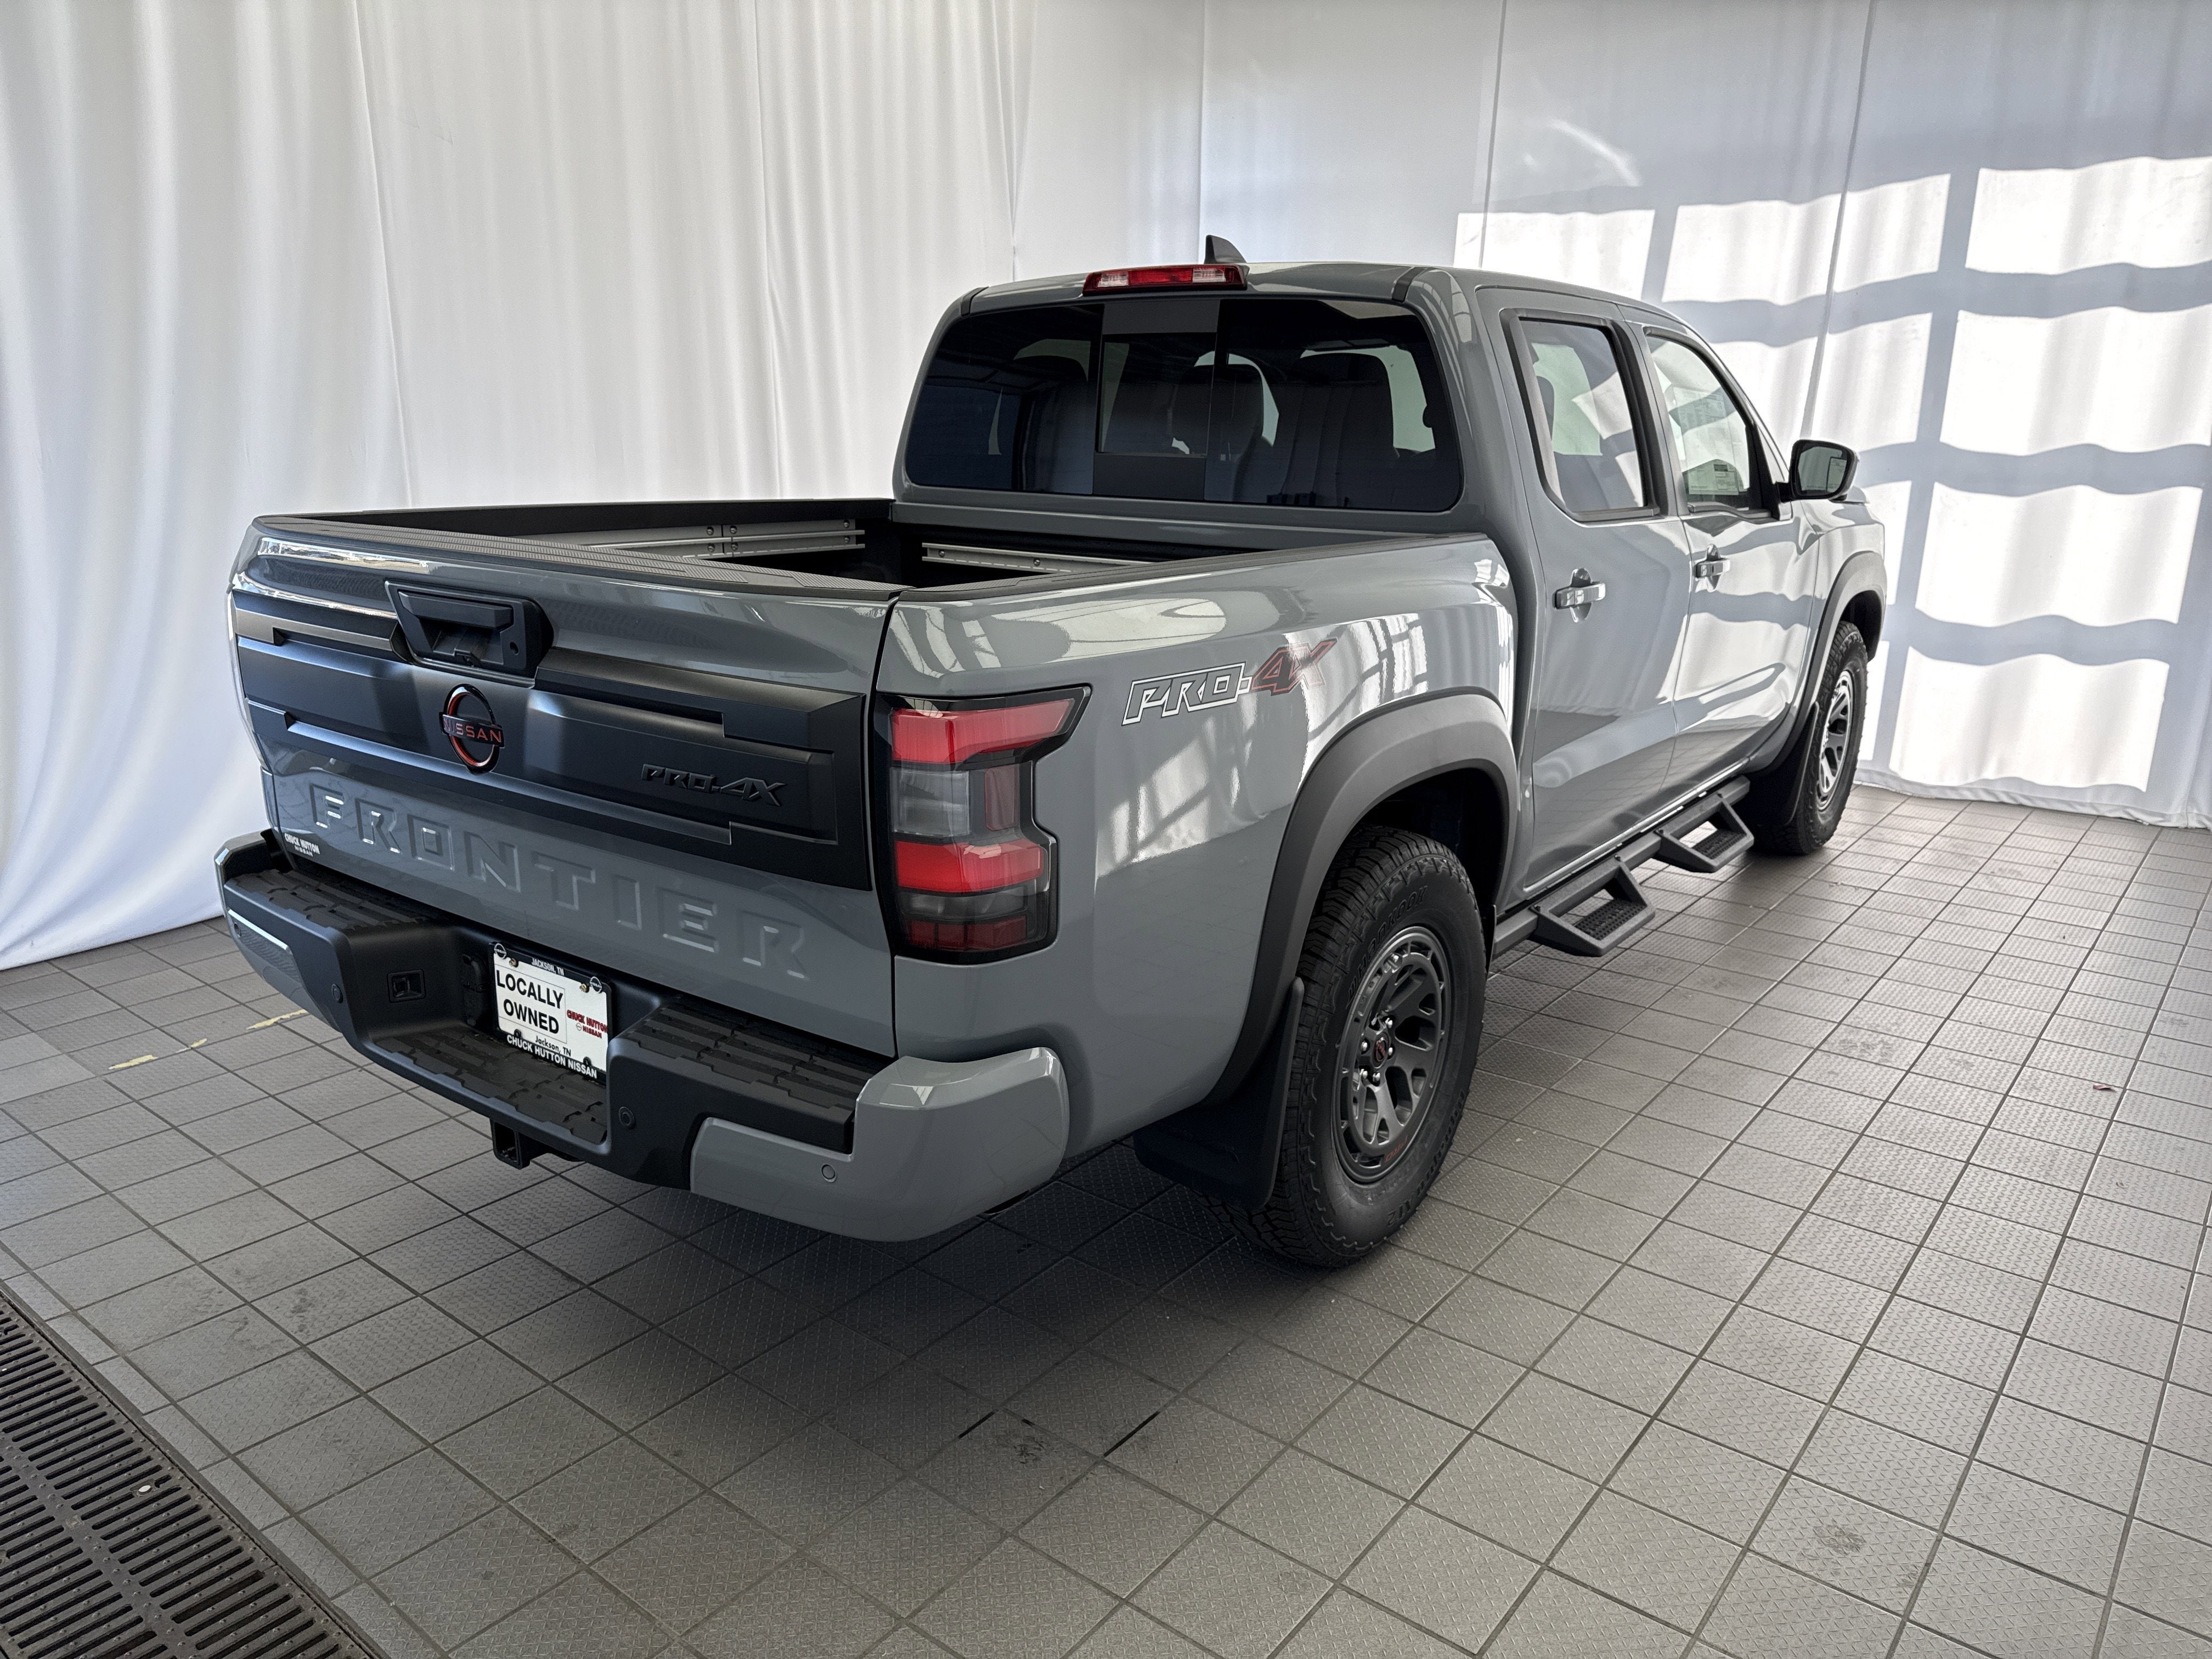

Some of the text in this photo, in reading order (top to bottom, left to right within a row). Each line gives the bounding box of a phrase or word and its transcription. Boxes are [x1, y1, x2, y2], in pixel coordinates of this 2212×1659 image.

[1121, 636, 1339, 726] PRO-4X
[443, 717, 502, 743] NISSAN
[641, 763, 787, 807] PRO-4X
[309, 783, 810, 981] FRONTIER
[531, 957, 565, 977] JACKSON, TN
[496, 969, 563, 1009] LOCALLY
[503, 998, 559, 1034] OWNED
[567, 1009, 585, 1024] CHUCK
[582, 1025, 602, 1039] NISSAN
[506, 1034, 597, 1079] CHUCK HUTTON NISSAN
[535, 1035, 572, 1057] Jackson, TN
